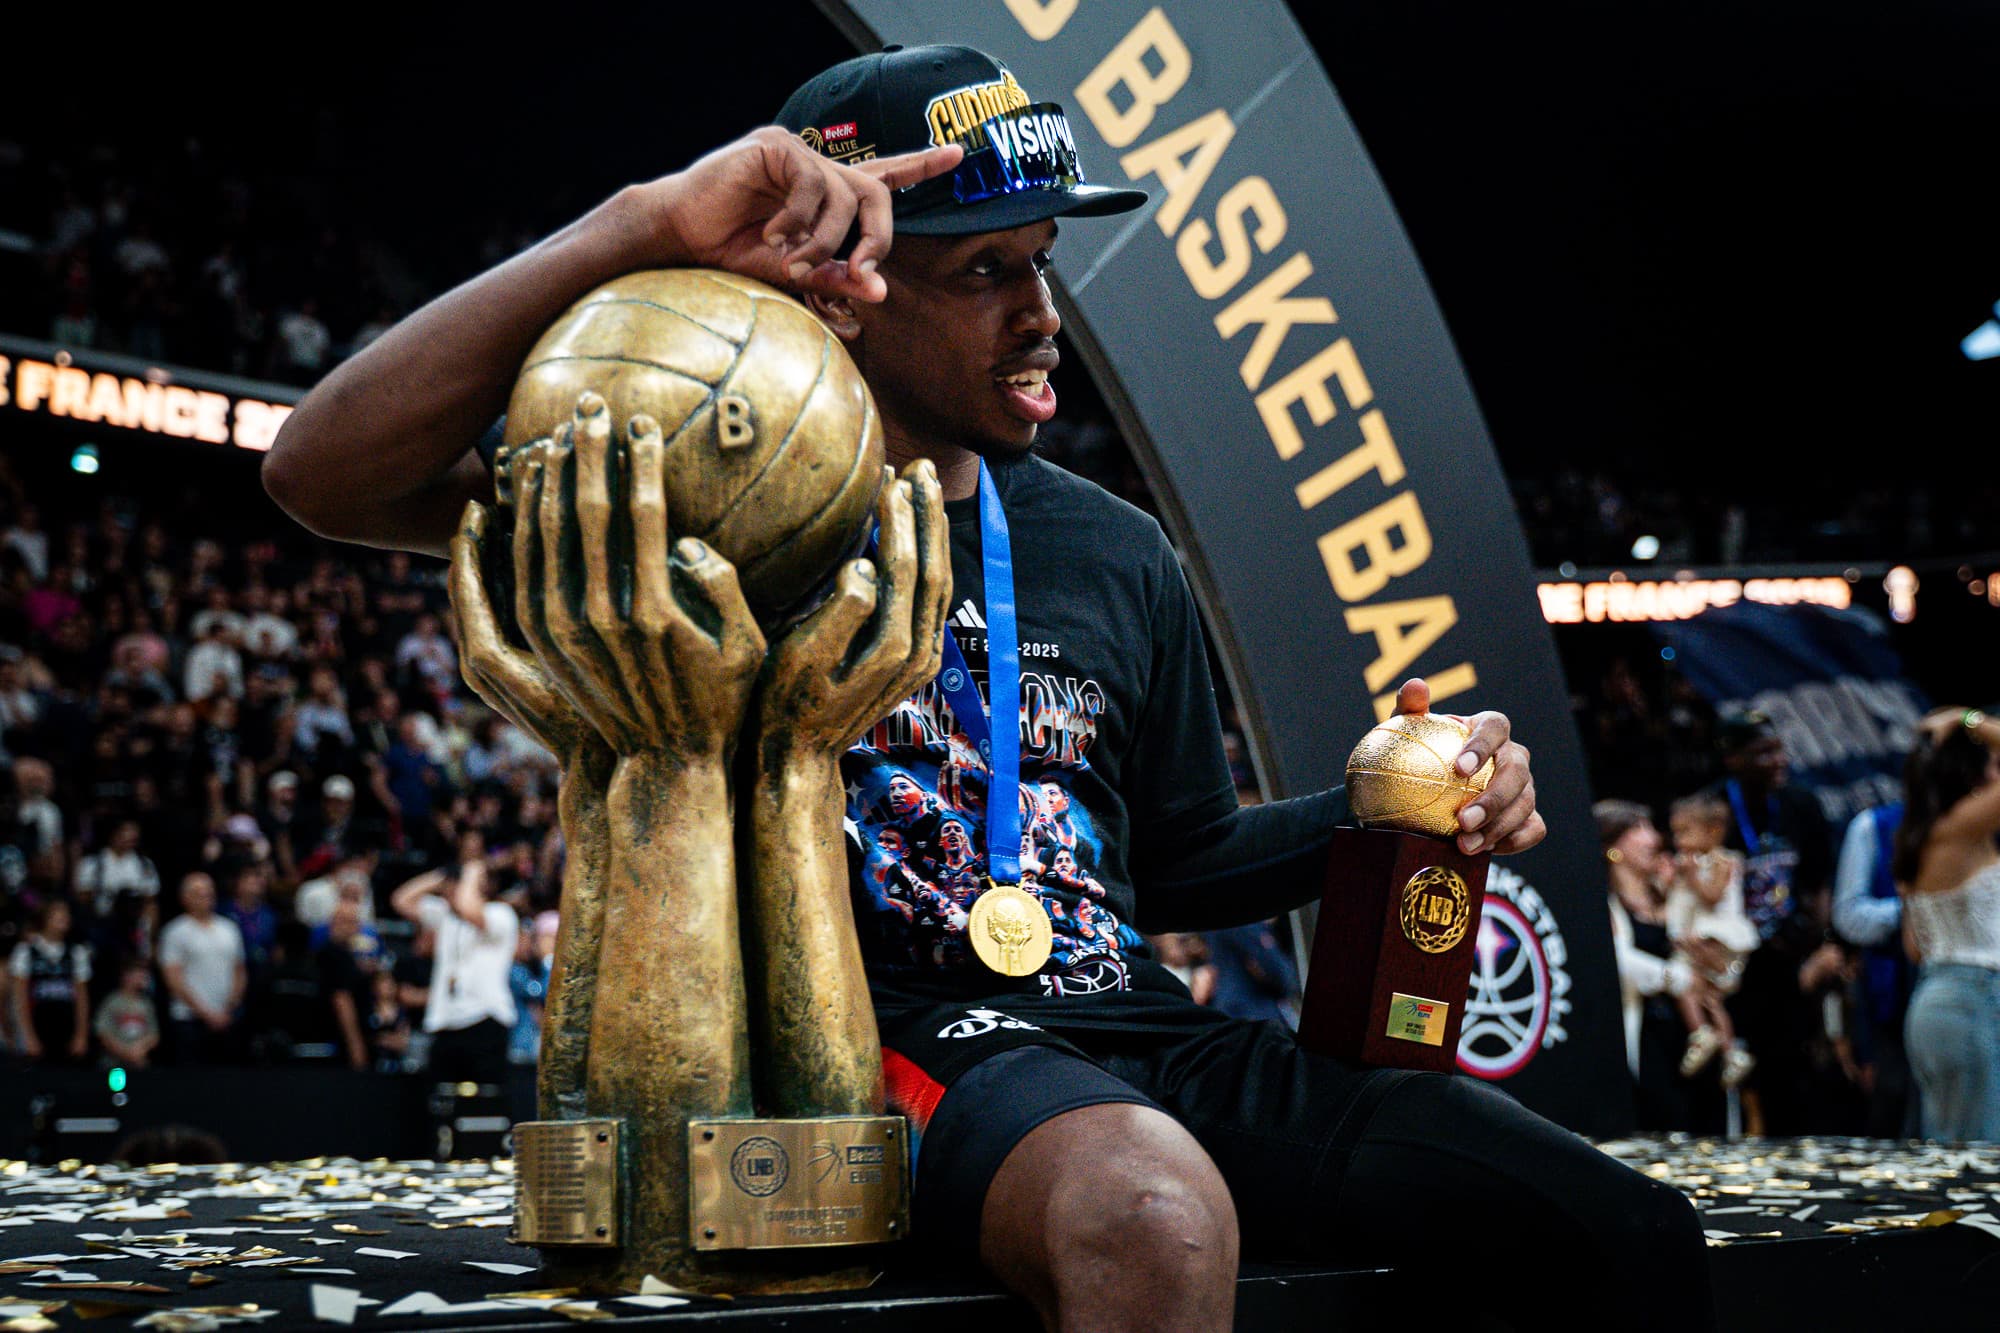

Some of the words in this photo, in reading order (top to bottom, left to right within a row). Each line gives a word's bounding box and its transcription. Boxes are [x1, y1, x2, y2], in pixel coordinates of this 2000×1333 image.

[828, 140, 859, 154] ÉLITE
[16, 358, 231, 444] FRANCE
[717, 395, 754, 449] B
[1419, 893, 1454, 926] LNB
